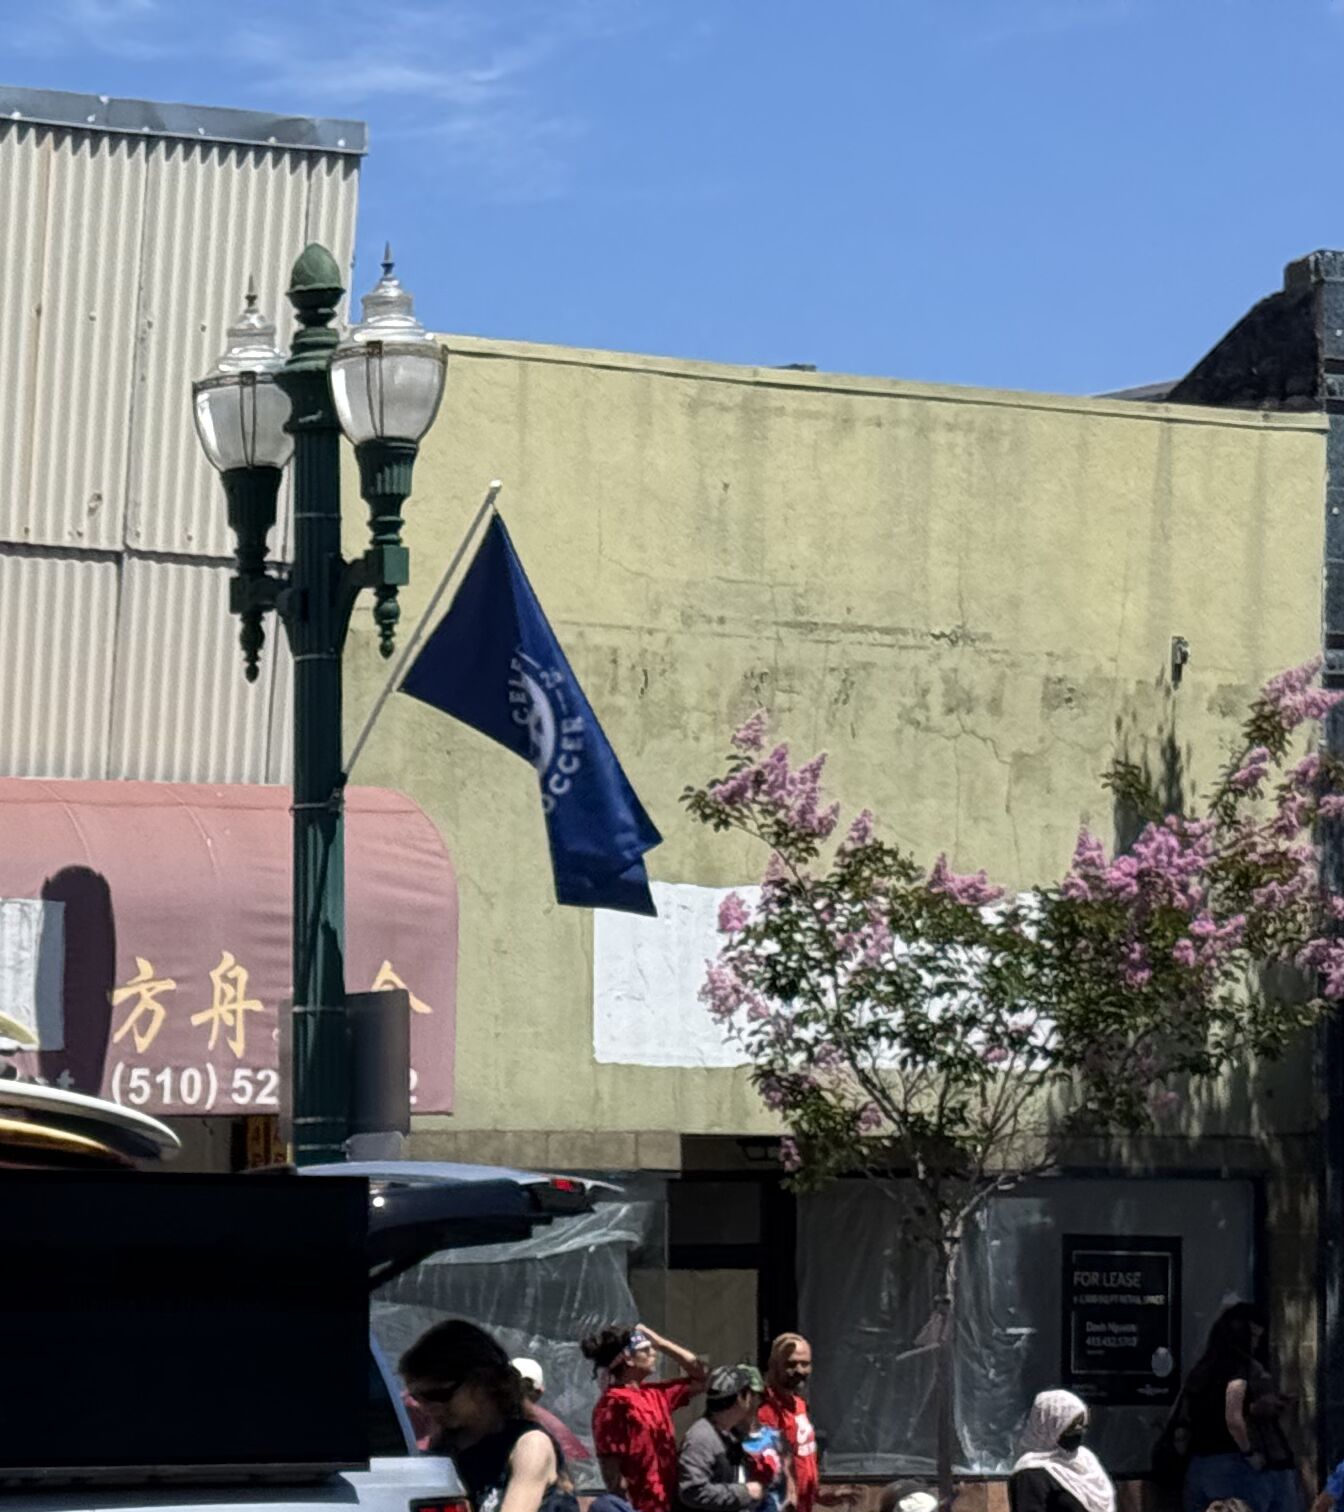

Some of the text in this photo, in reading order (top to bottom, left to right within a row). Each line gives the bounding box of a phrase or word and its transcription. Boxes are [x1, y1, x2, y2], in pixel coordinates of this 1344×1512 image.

[112, 1061, 218, 1112] (510)
[1073, 1271, 1142, 1288] FOR LEASE
